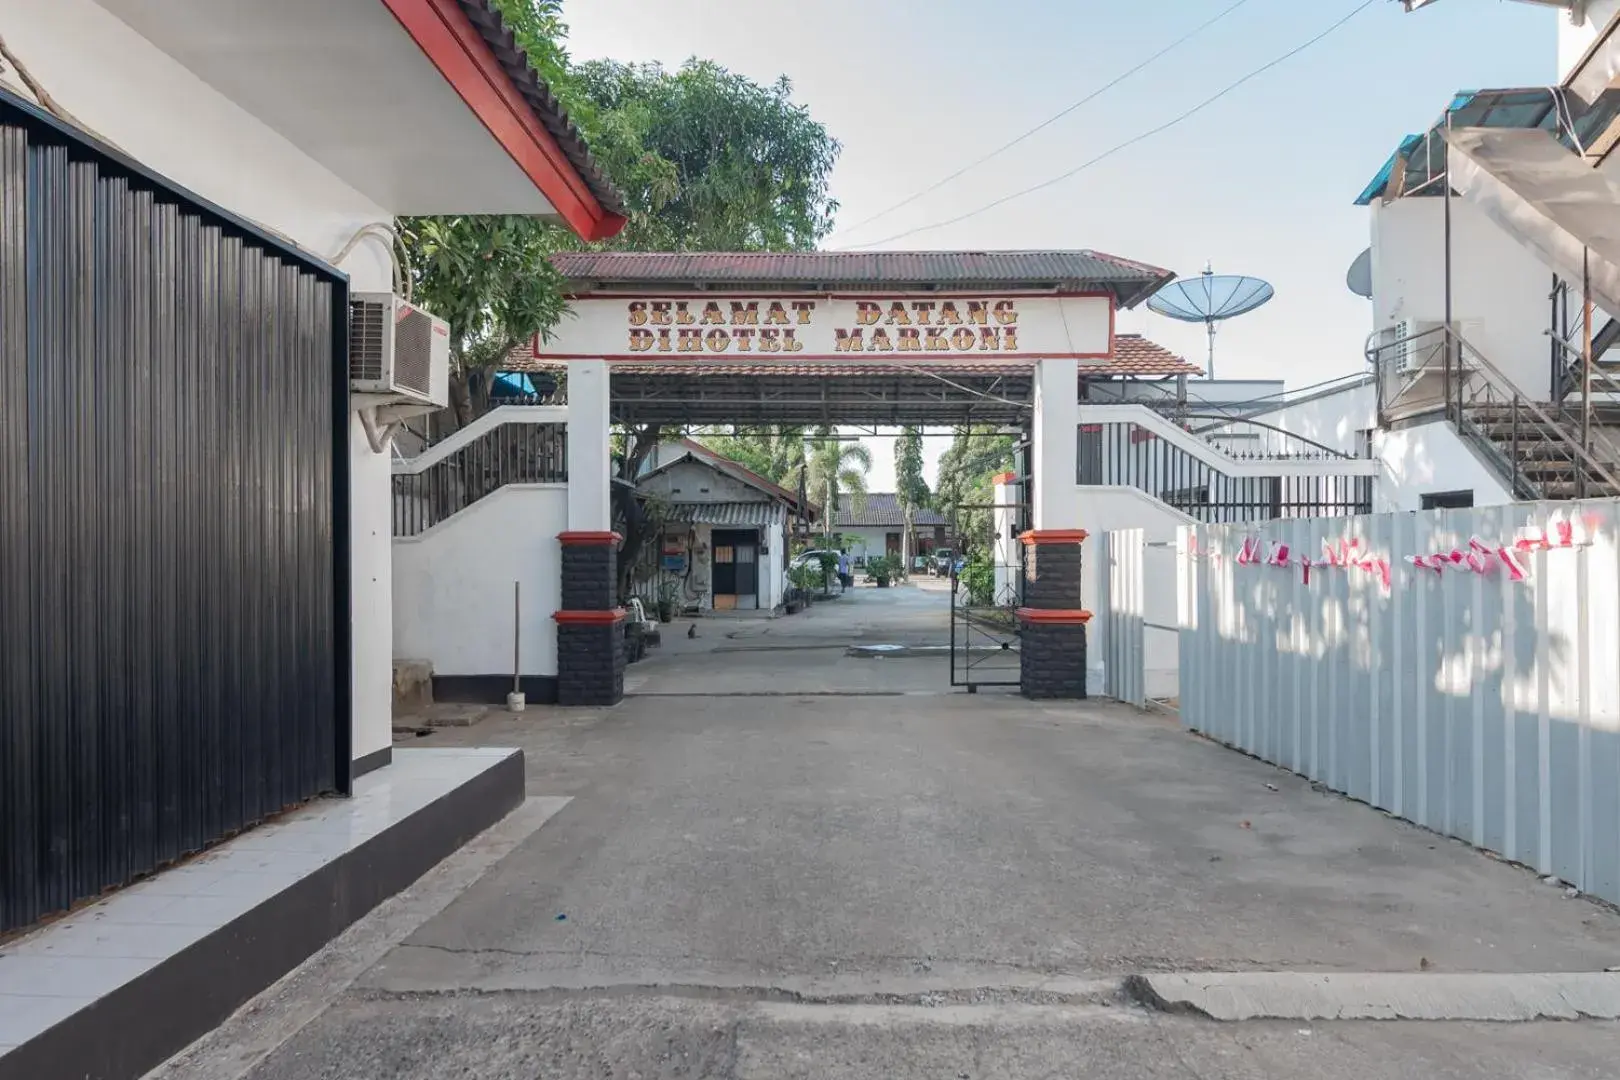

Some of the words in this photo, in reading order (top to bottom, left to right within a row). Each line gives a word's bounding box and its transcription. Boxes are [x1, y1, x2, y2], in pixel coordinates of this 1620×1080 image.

[628, 301, 816, 326] SELAMAT
[855, 301, 1019, 325] DATANG
[833, 327, 1018, 352] MARKONI
